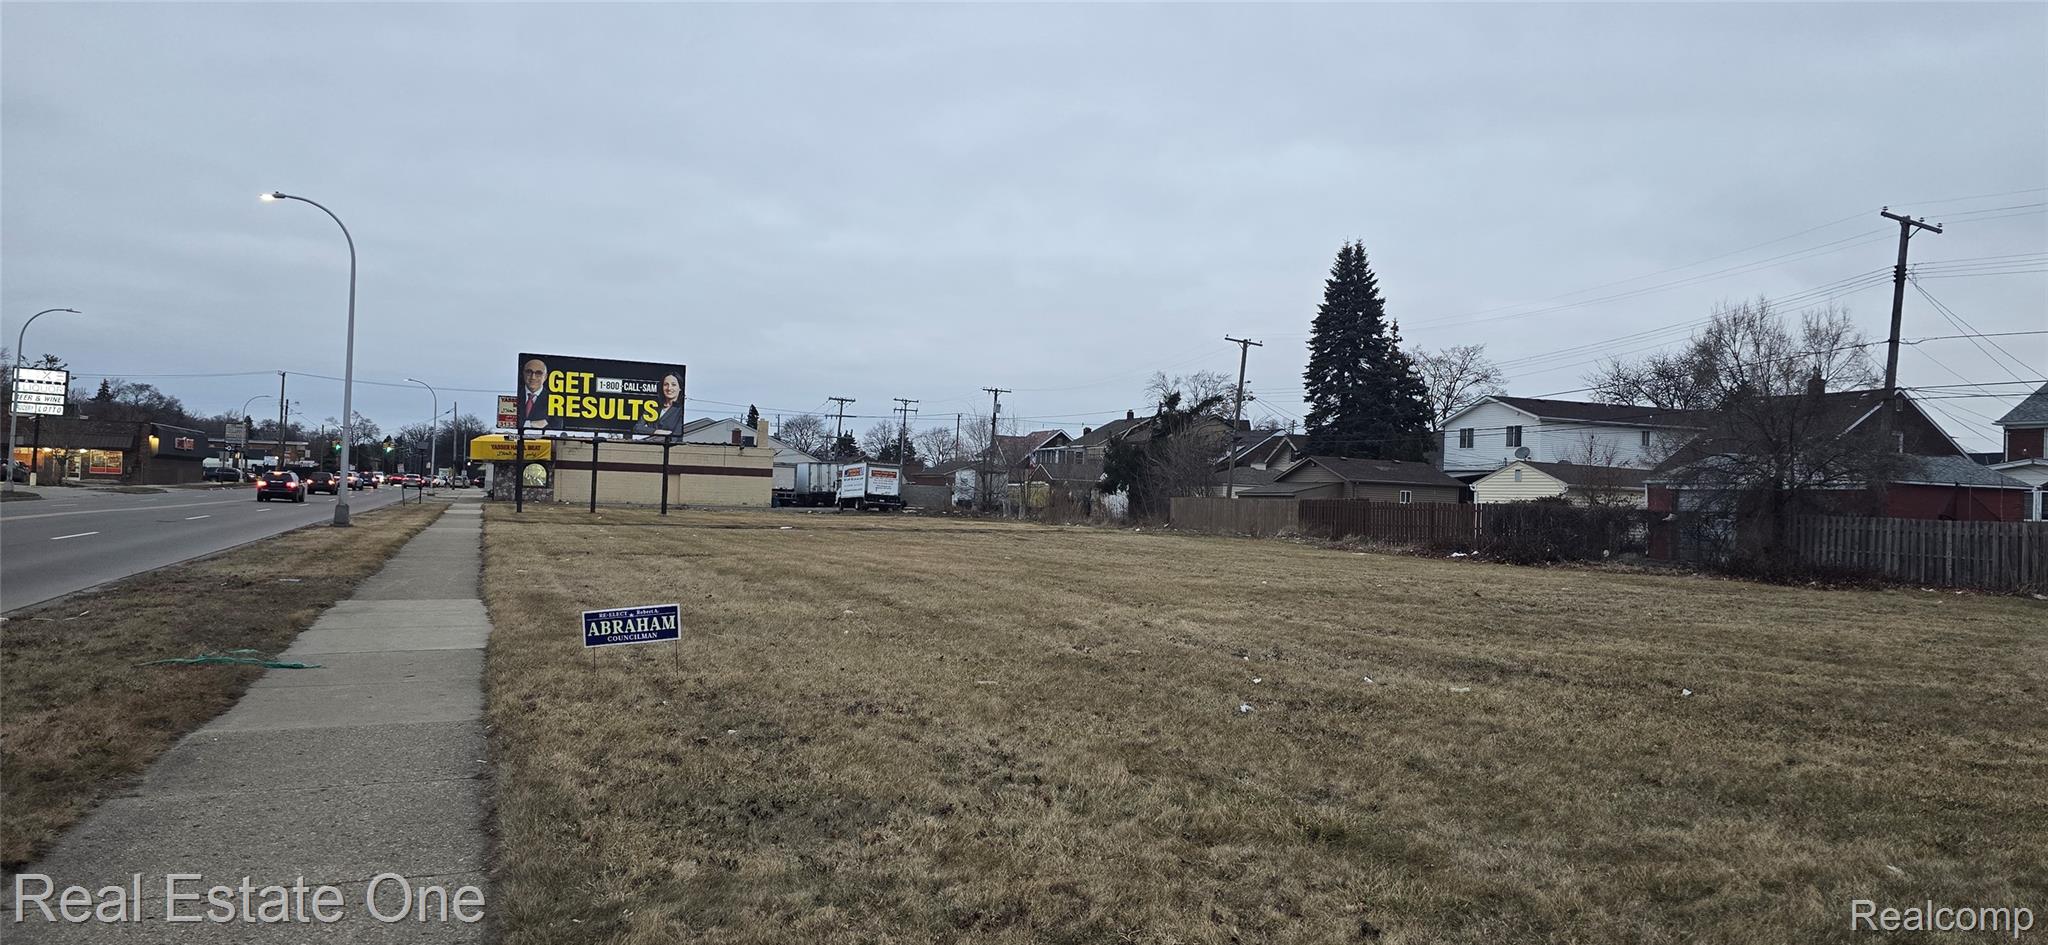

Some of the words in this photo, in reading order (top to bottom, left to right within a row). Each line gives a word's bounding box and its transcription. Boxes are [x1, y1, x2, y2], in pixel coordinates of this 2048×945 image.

[548, 370, 594, 394] GET
[548, 394, 659, 422] RESULTS
[588, 615, 676, 637] ABRAHAM
[607, 632, 658, 642] COUNCILMAN
